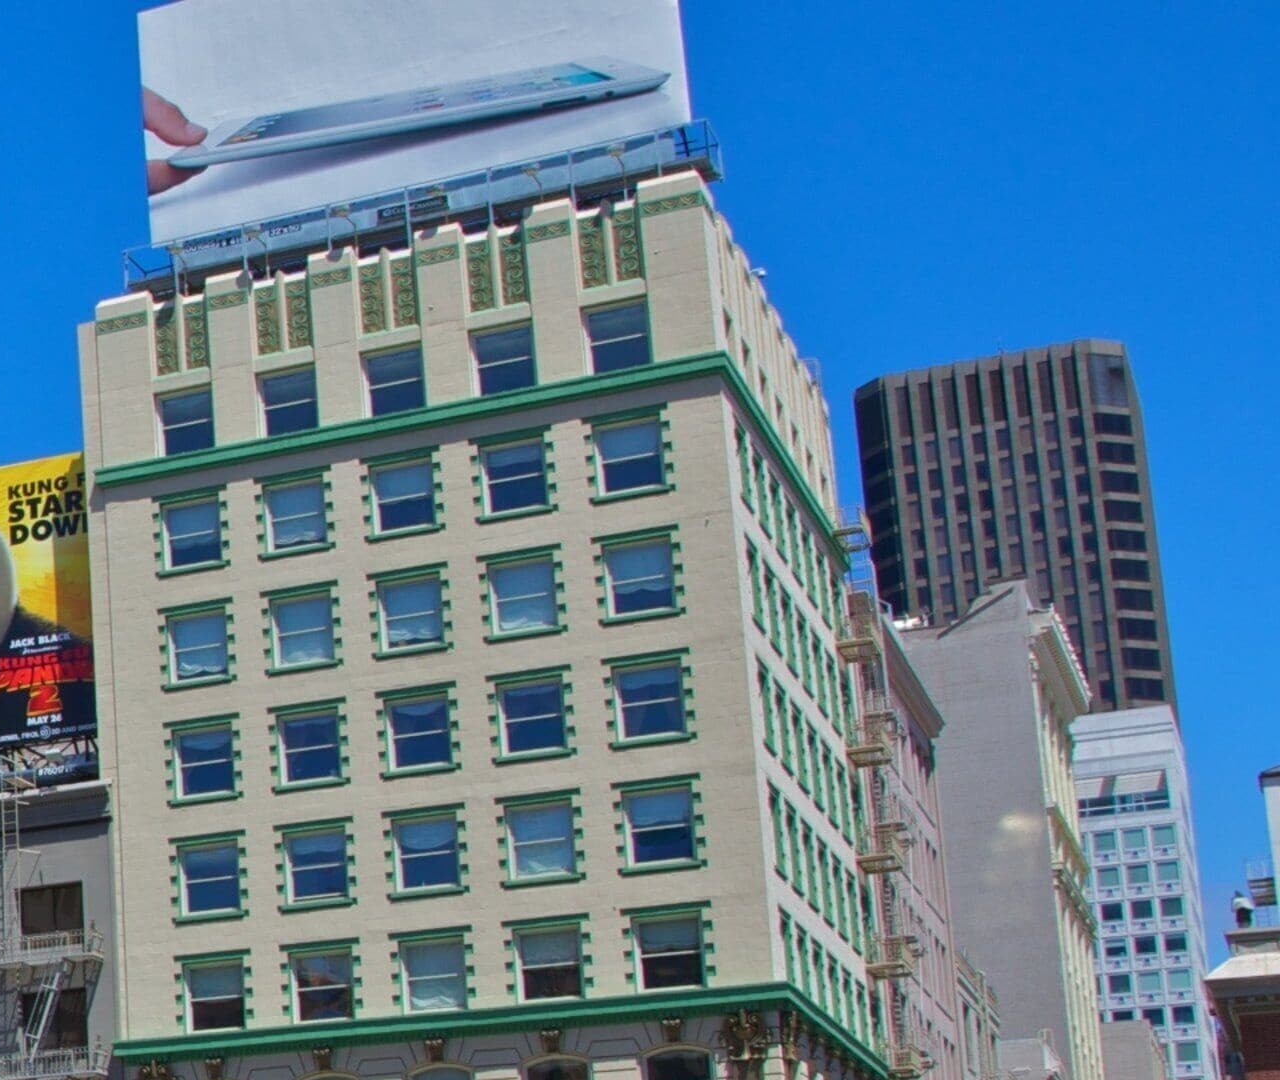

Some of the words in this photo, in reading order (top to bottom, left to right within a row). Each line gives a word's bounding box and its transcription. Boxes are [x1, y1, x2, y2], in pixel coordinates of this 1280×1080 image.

[8, 476, 68, 500] KUNG
[8, 490, 83, 523] STAR
[10, 512, 88, 546] DOW
[9, 637, 35, 649] JACK
[38, 632, 71, 645] BLACK
[26, 685, 63, 716] 2
[27, 716, 49, 727] MAY
